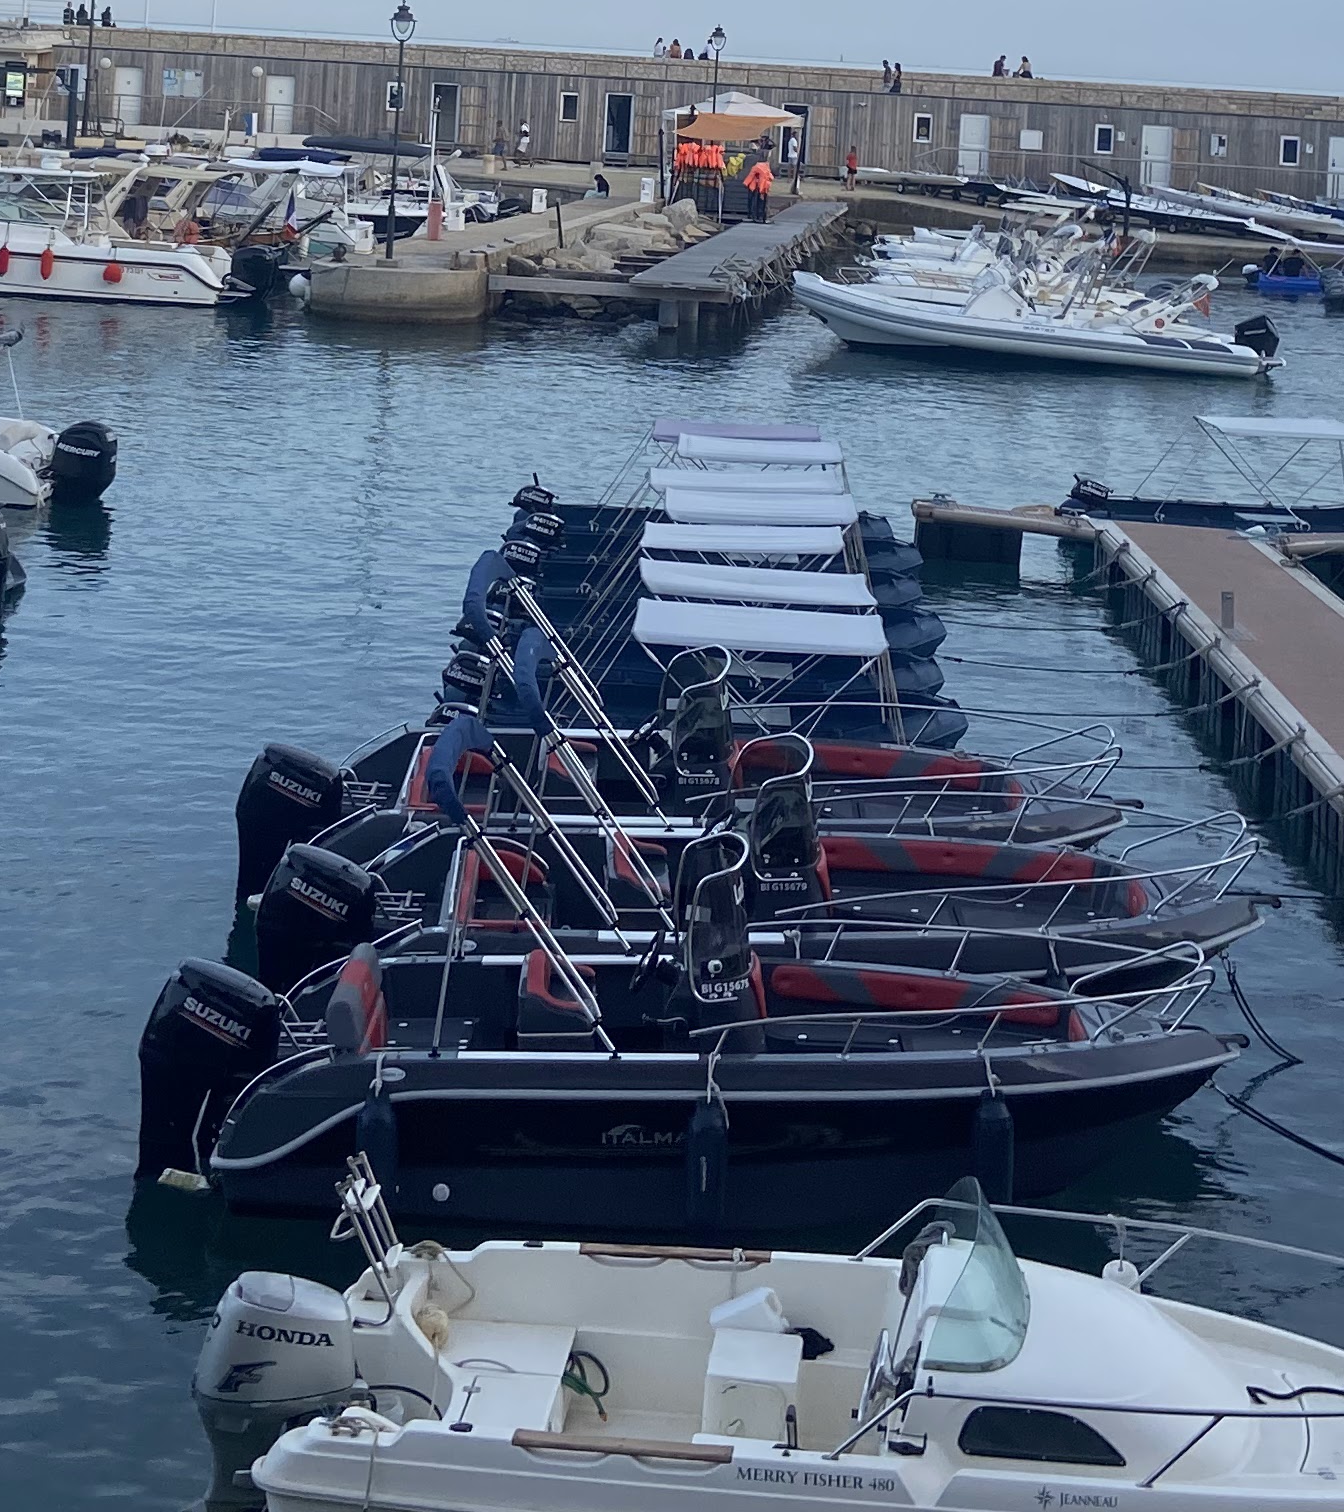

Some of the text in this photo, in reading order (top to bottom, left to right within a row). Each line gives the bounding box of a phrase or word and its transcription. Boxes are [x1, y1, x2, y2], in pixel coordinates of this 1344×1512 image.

[57, 442, 101, 458] MERCURY
[269, 771, 322, 803] SUZUKI
[290, 877, 349, 916] SUZUKI
[183, 996, 252, 1040] SUZUKI
[236, 1320, 335, 1346] HONDA
[736, 1467, 895, 1492] MERRY FISHER 480
[1059, 1491, 1118, 1508] JEANNEAU
